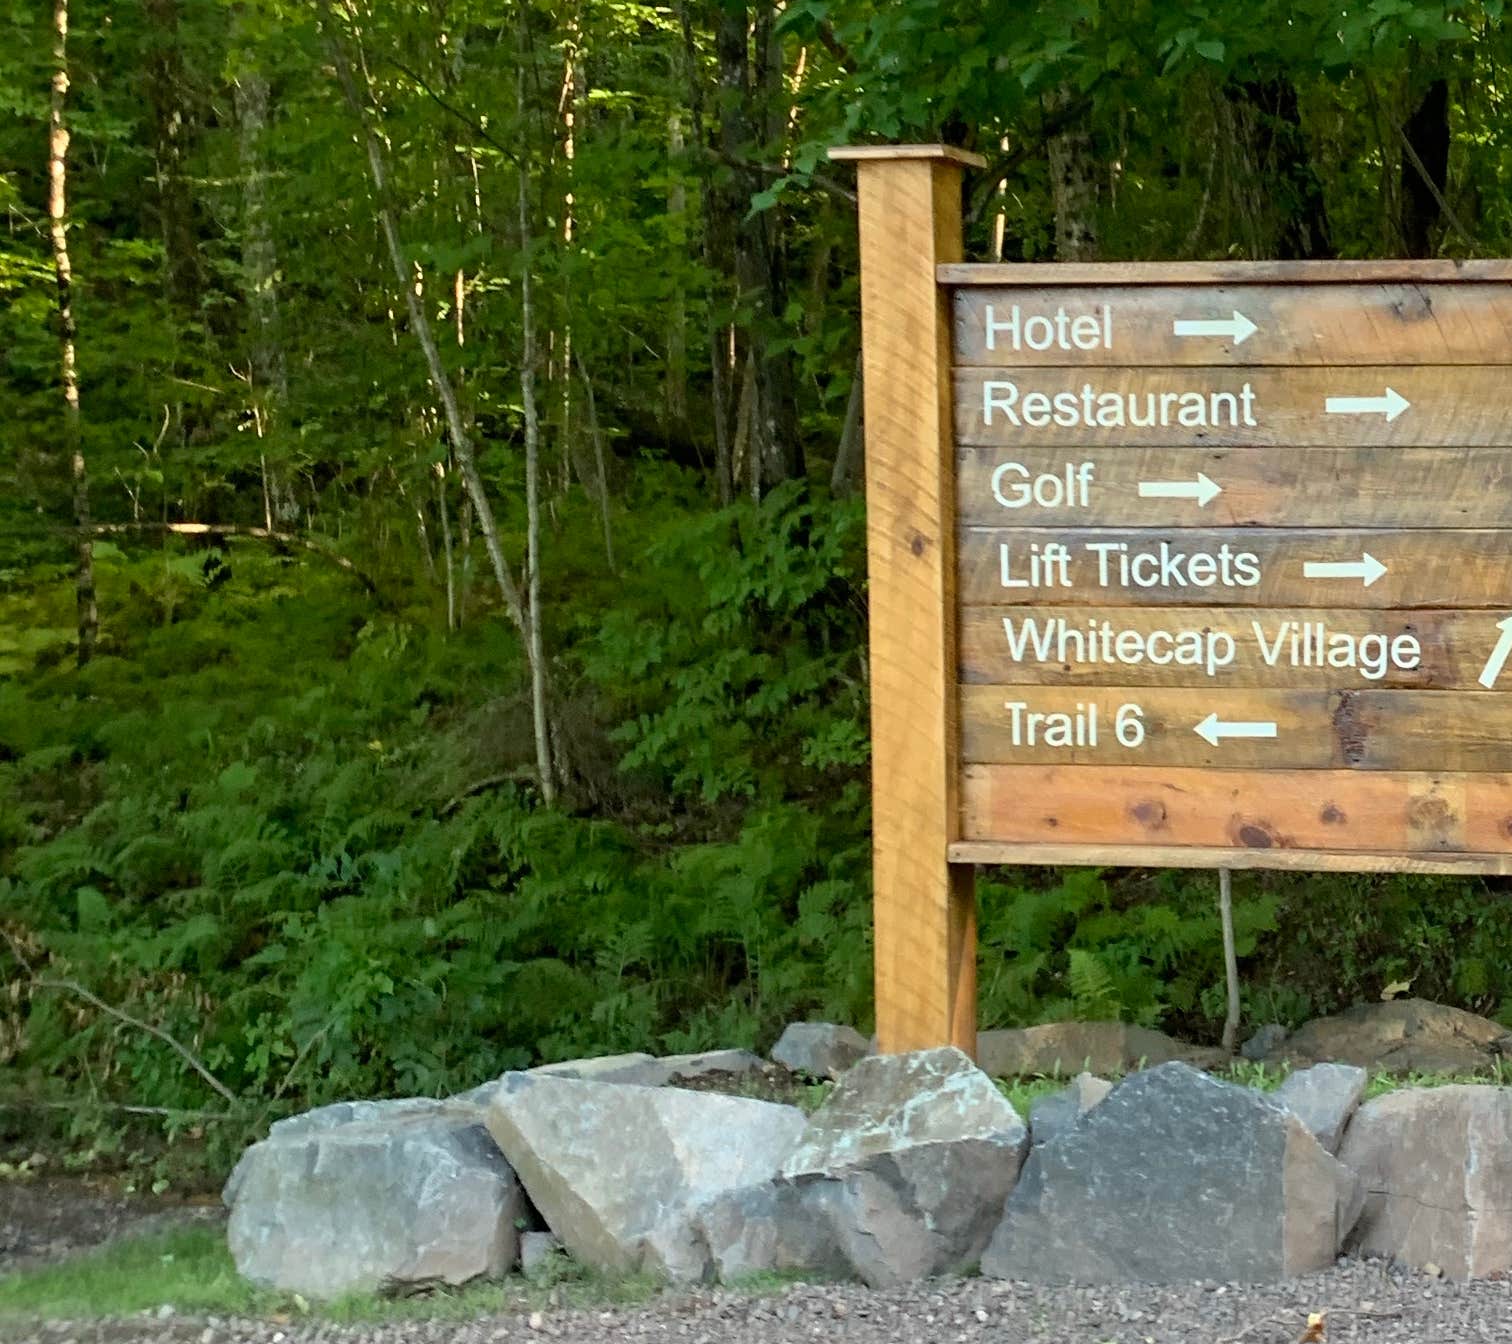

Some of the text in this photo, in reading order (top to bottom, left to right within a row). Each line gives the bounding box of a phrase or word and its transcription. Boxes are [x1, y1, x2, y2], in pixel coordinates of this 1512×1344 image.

[984, 304, 1112, 351] Hotel
[984, 381, 1256, 428] Restaurant
[991, 462, 1094, 508] Golf
[1000, 542, 1261, 587] Lift Tickets
[1003, 618, 1421, 680] Whitecap Village
[1007, 702, 1145, 748] Trail 6
